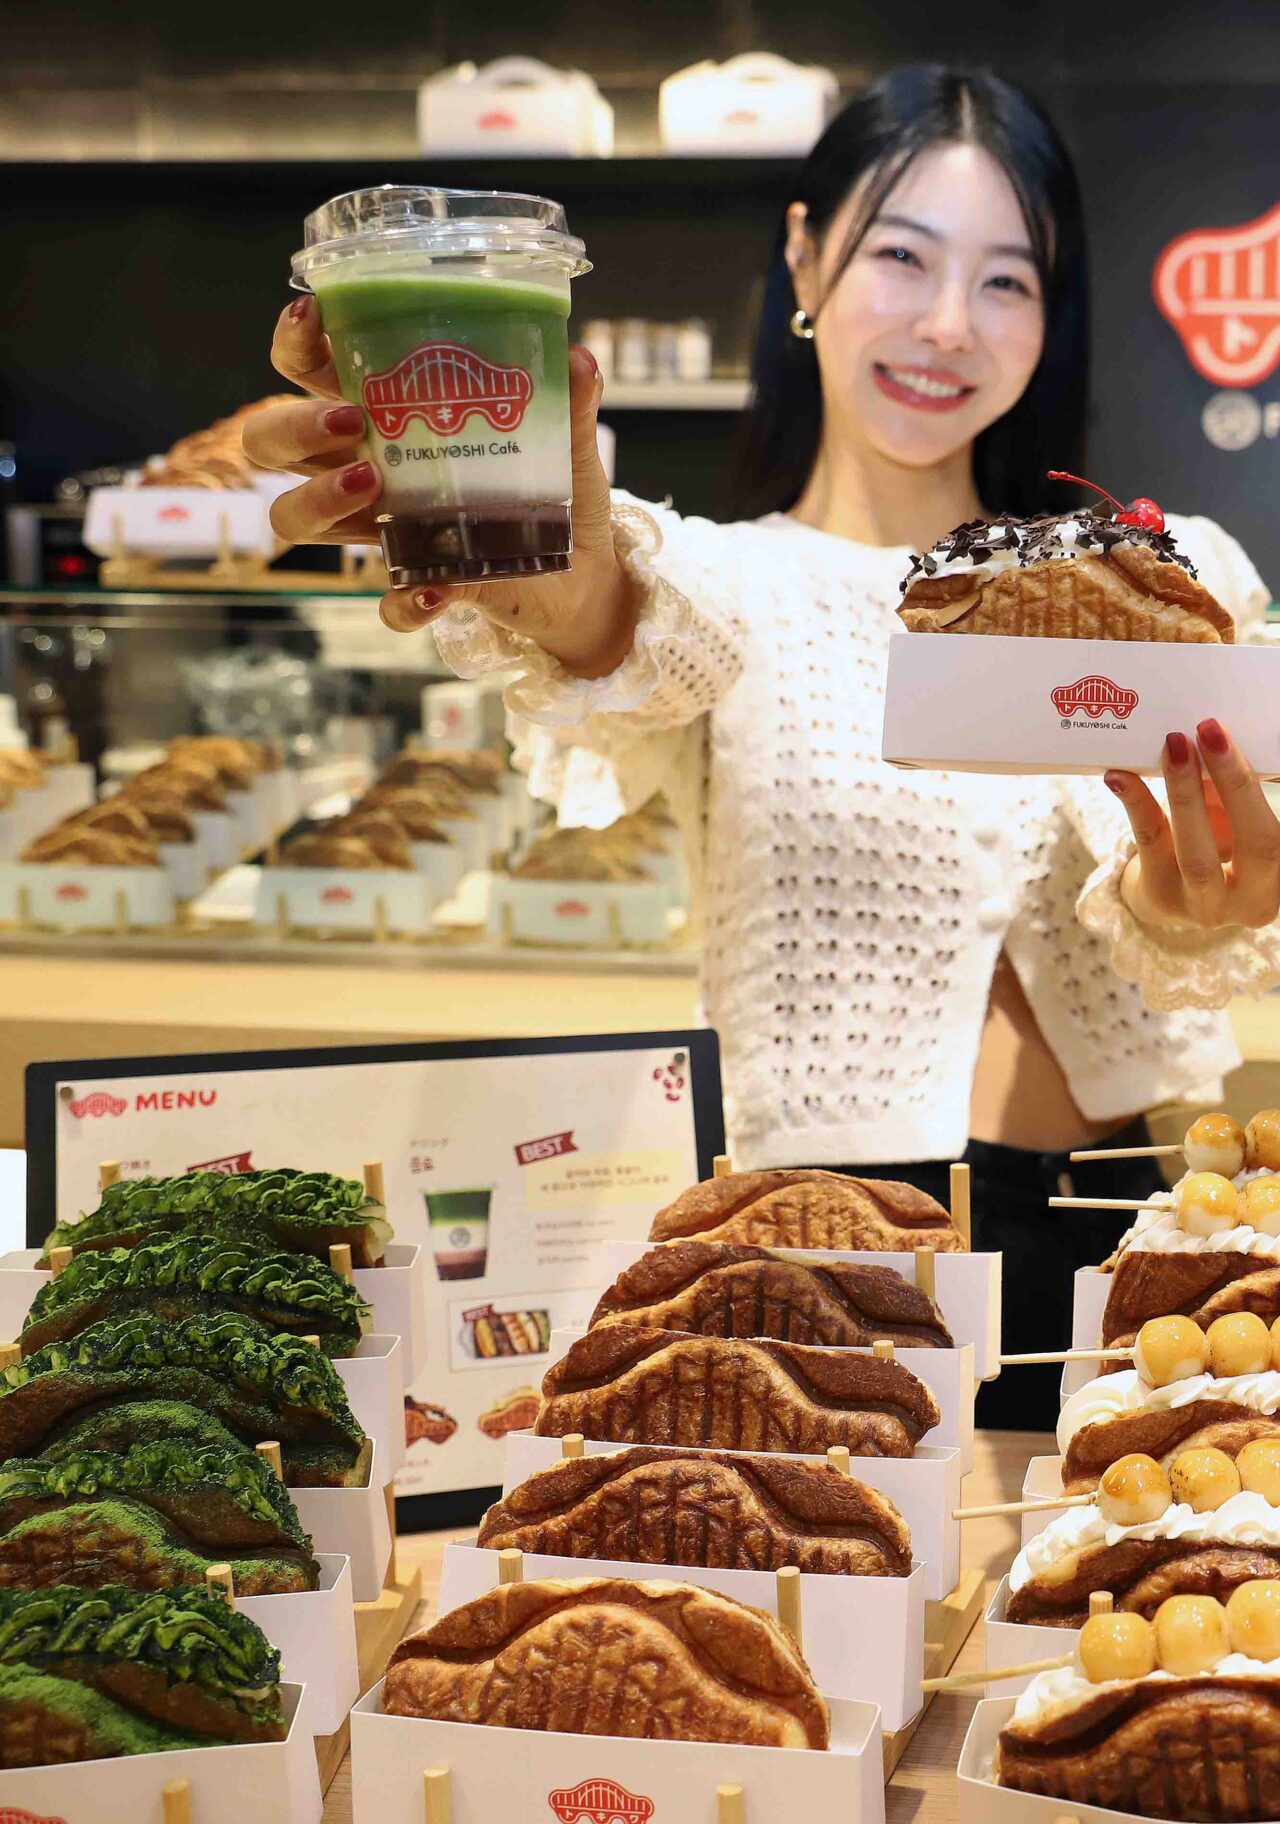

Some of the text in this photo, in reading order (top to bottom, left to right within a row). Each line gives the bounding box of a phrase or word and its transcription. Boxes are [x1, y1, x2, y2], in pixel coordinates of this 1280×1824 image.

[385, 403, 512, 427] トキワ
[406, 444, 485, 461] FUKUYOSHI
[1073, 721, 1110, 729] FUKUYOSHI
[136, 1090, 217, 1112] MENU
[522, 1138, 566, 1161] BEST
